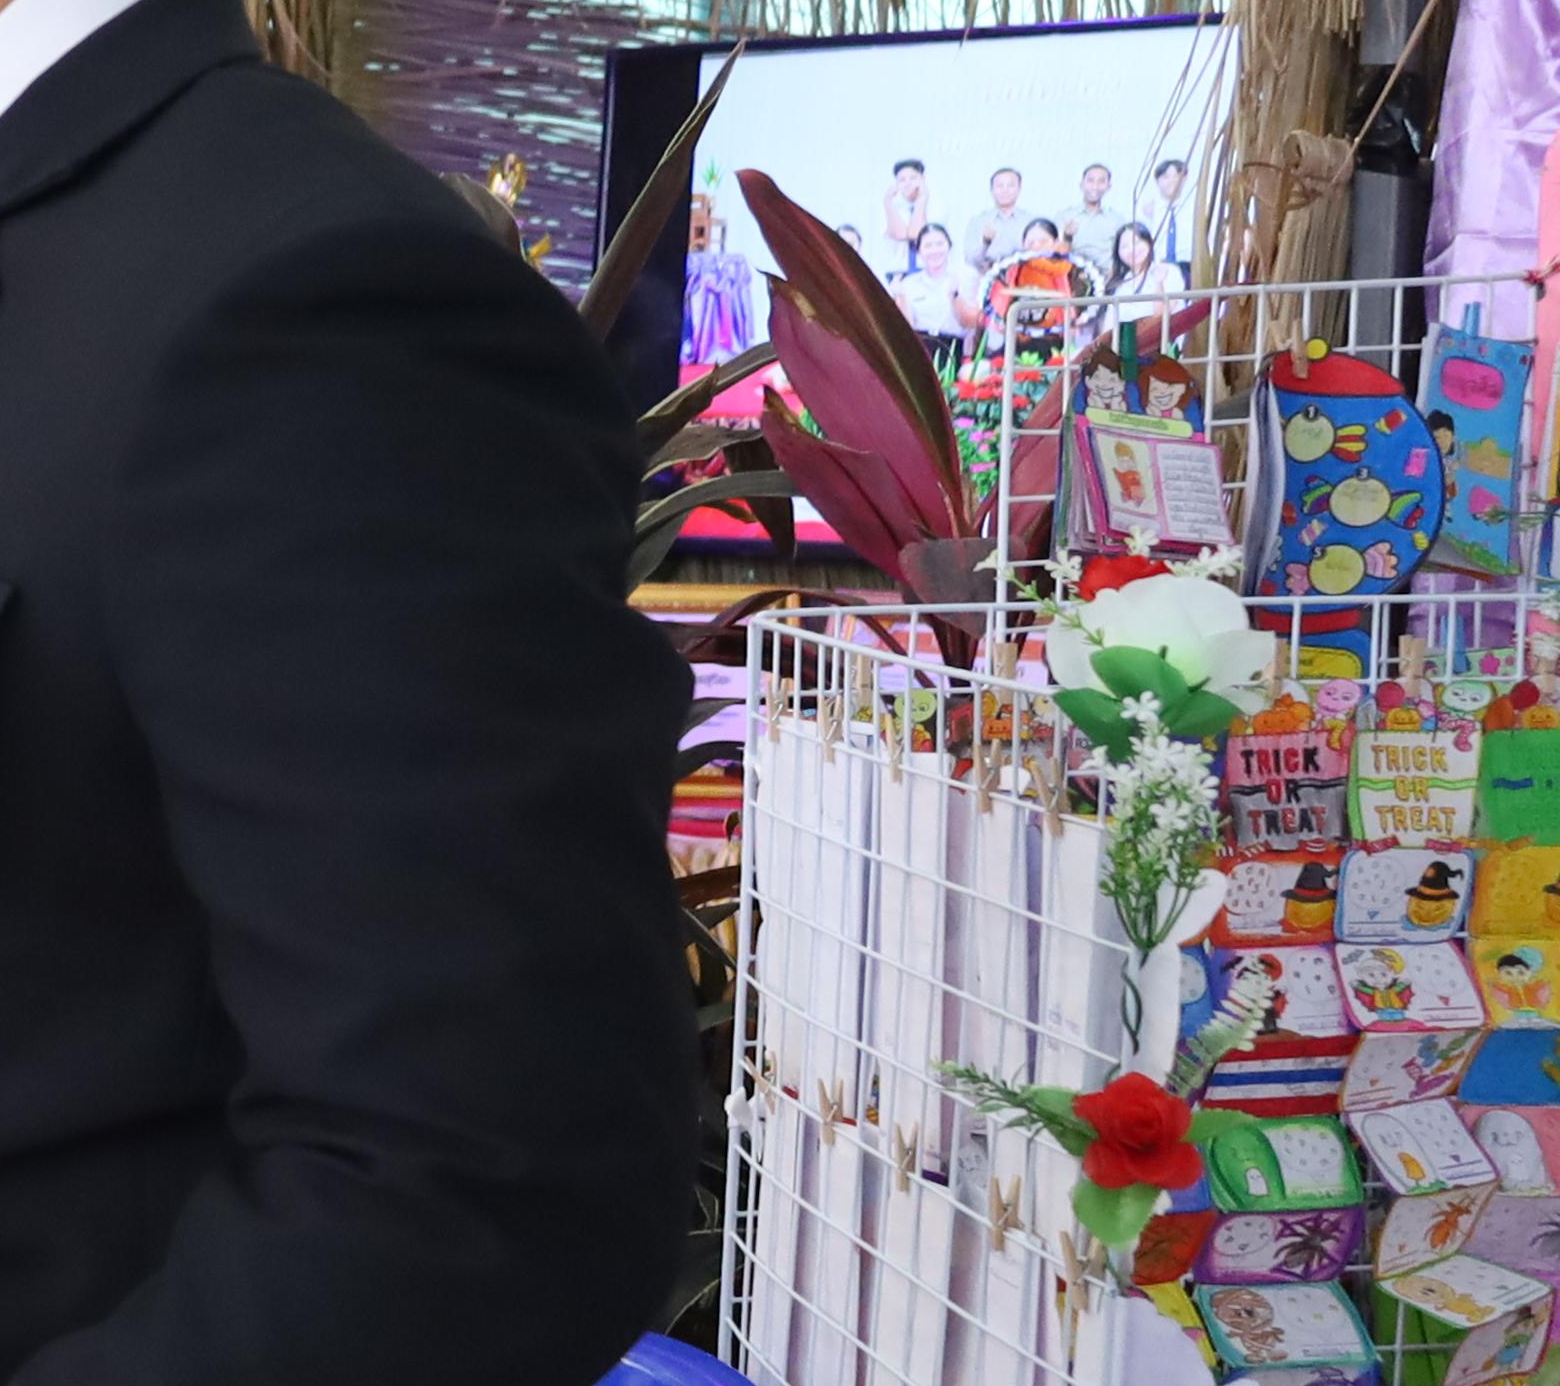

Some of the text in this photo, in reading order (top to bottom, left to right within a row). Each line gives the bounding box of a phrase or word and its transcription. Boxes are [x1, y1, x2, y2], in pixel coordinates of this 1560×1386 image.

[1240, 746, 1320, 778] TRICK
[1371, 745, 1449, 774] TRICK
[1266, 777, 1302, 806] OR
[1394, 775, 1429, 803] OR
[1247, 805, 1327, 838] TREAT
[1374, 805, 1457, 836] TREAT
